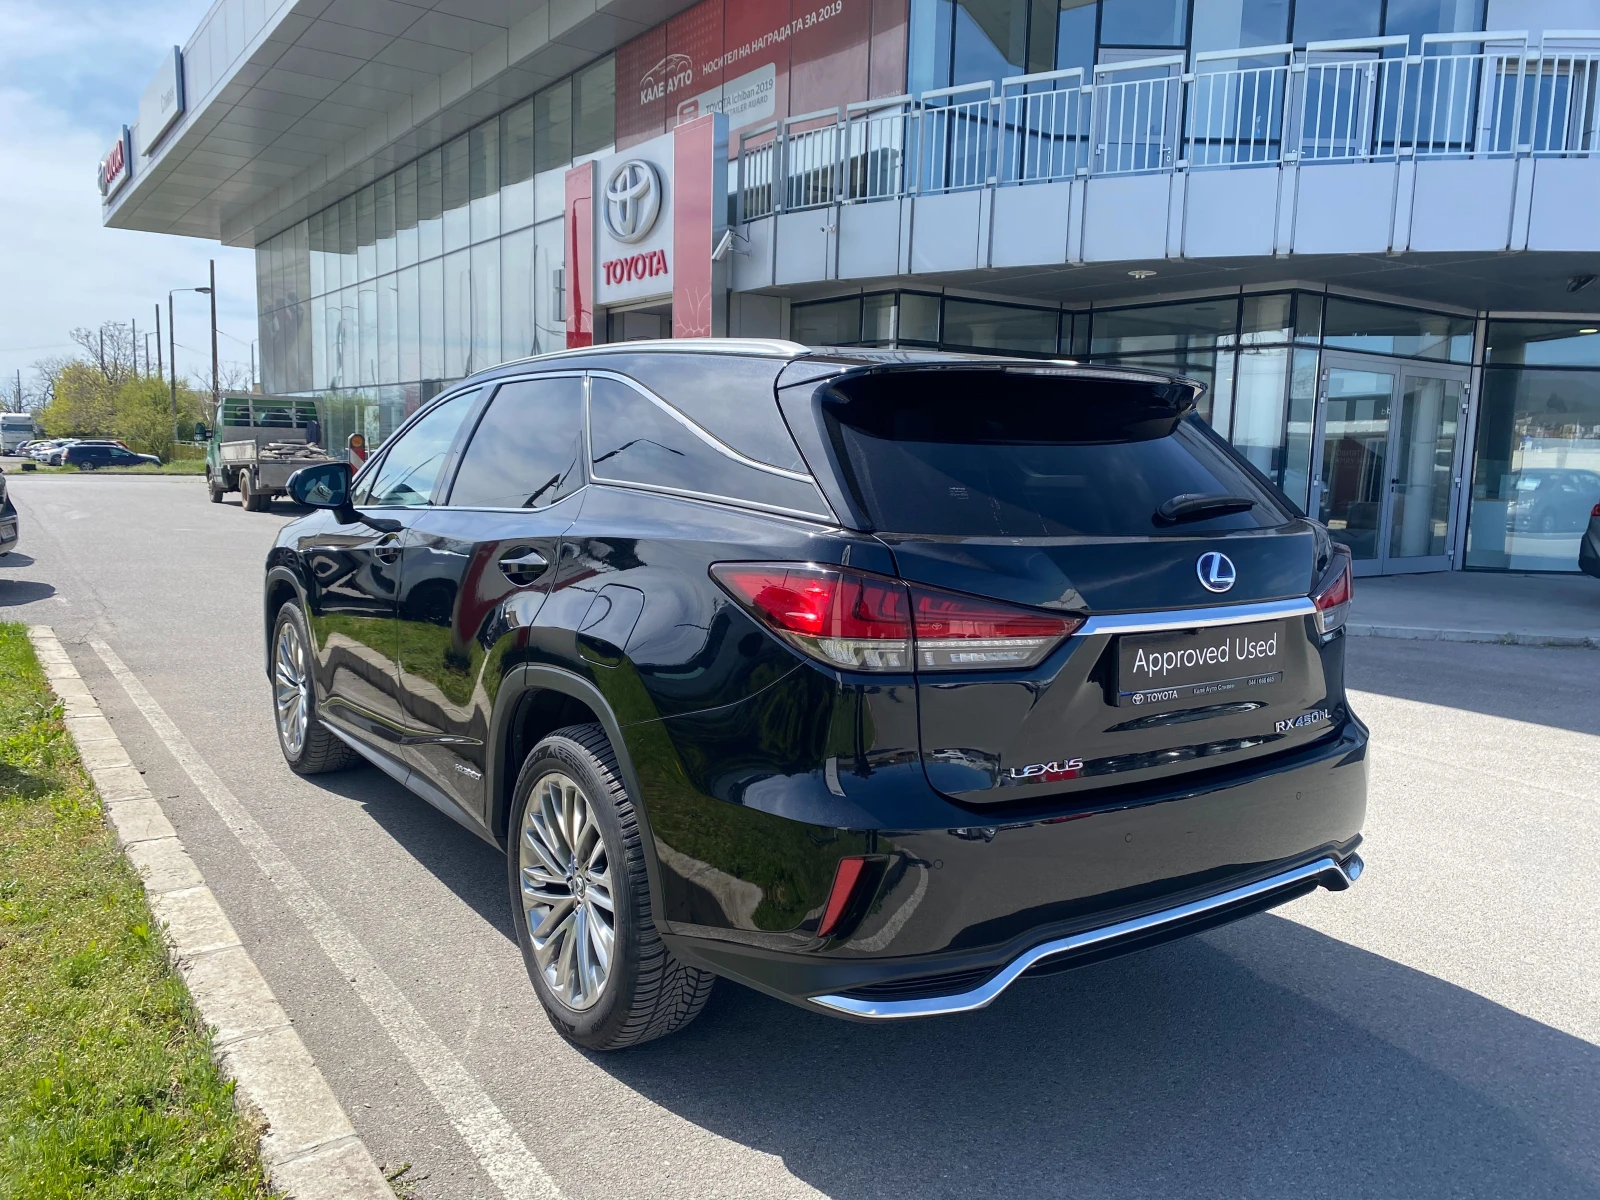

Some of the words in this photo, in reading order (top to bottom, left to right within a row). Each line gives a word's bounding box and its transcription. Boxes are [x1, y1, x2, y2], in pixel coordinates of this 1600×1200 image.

[703, 49, 738, 75] НОСИТЕЛ
[739, 43, 750, 59] НА
[805, 12, 817, 28] ЗА
[818, 0, 842, 21] 2019
[640, 84, 665, 105] КАЛЕ
[667, 69, 692, 94] АУТО
[705, 96, 731, 114] TOYOTA
[755, 78, 773, 95] 2019
[602, 249, 668, 285] TOYOTA
[1132, 637, 1229, 677] Approved
[1236, 632, 1277, 660] Used
[1146, 690, 1178, 703] TOYOTA
[1009, 757, 1083, 778] LEXUS
